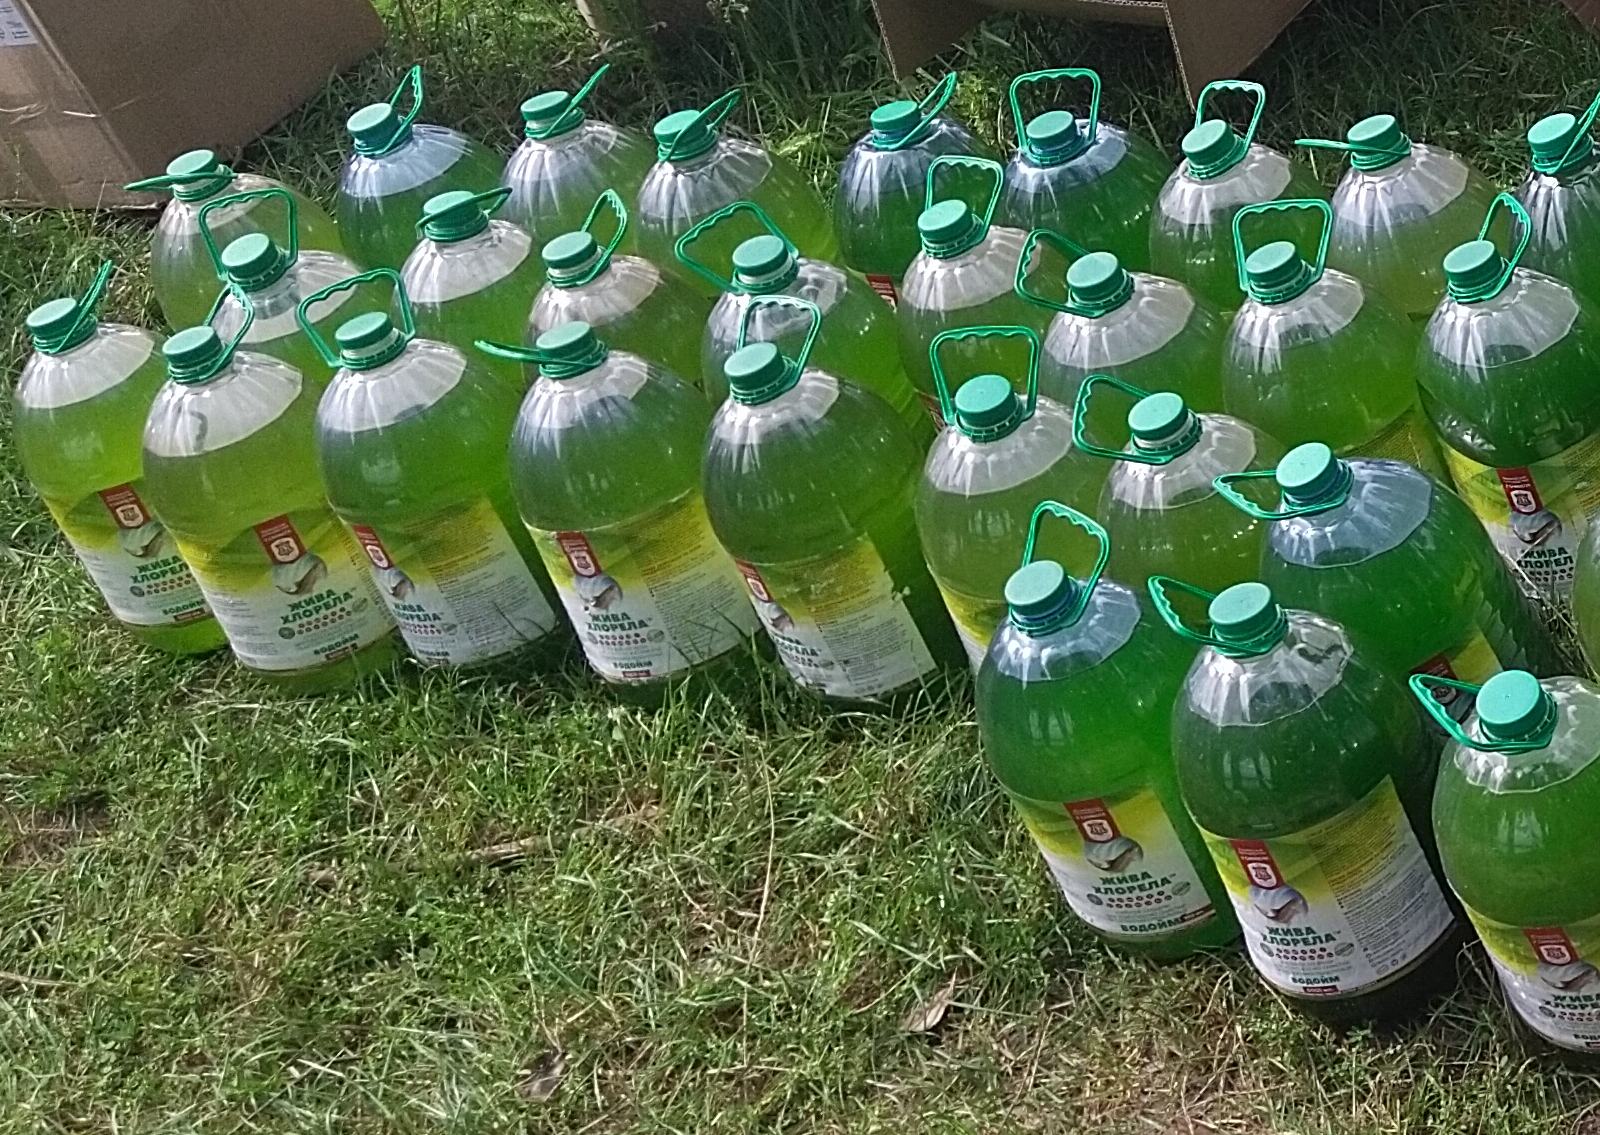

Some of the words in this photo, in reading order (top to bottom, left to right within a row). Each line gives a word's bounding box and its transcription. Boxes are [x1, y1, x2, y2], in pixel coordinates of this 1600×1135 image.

[136, 555, 182, 574] ЖИВА
[130, 562, 190, 584] ХЛОРЕЛ
[287, 589, 336, 612] ЖИВА
[588, 611, 631, 623] ЖИВА
[1092, 877, 1172, 895] ХЛОРЕЛА
[1100, 871, 1153, 886] ЖИВА
[1266, 926, 1317, 937] ЖИВА
[1291, 975, 1340, 986] ВОДОЙМ
